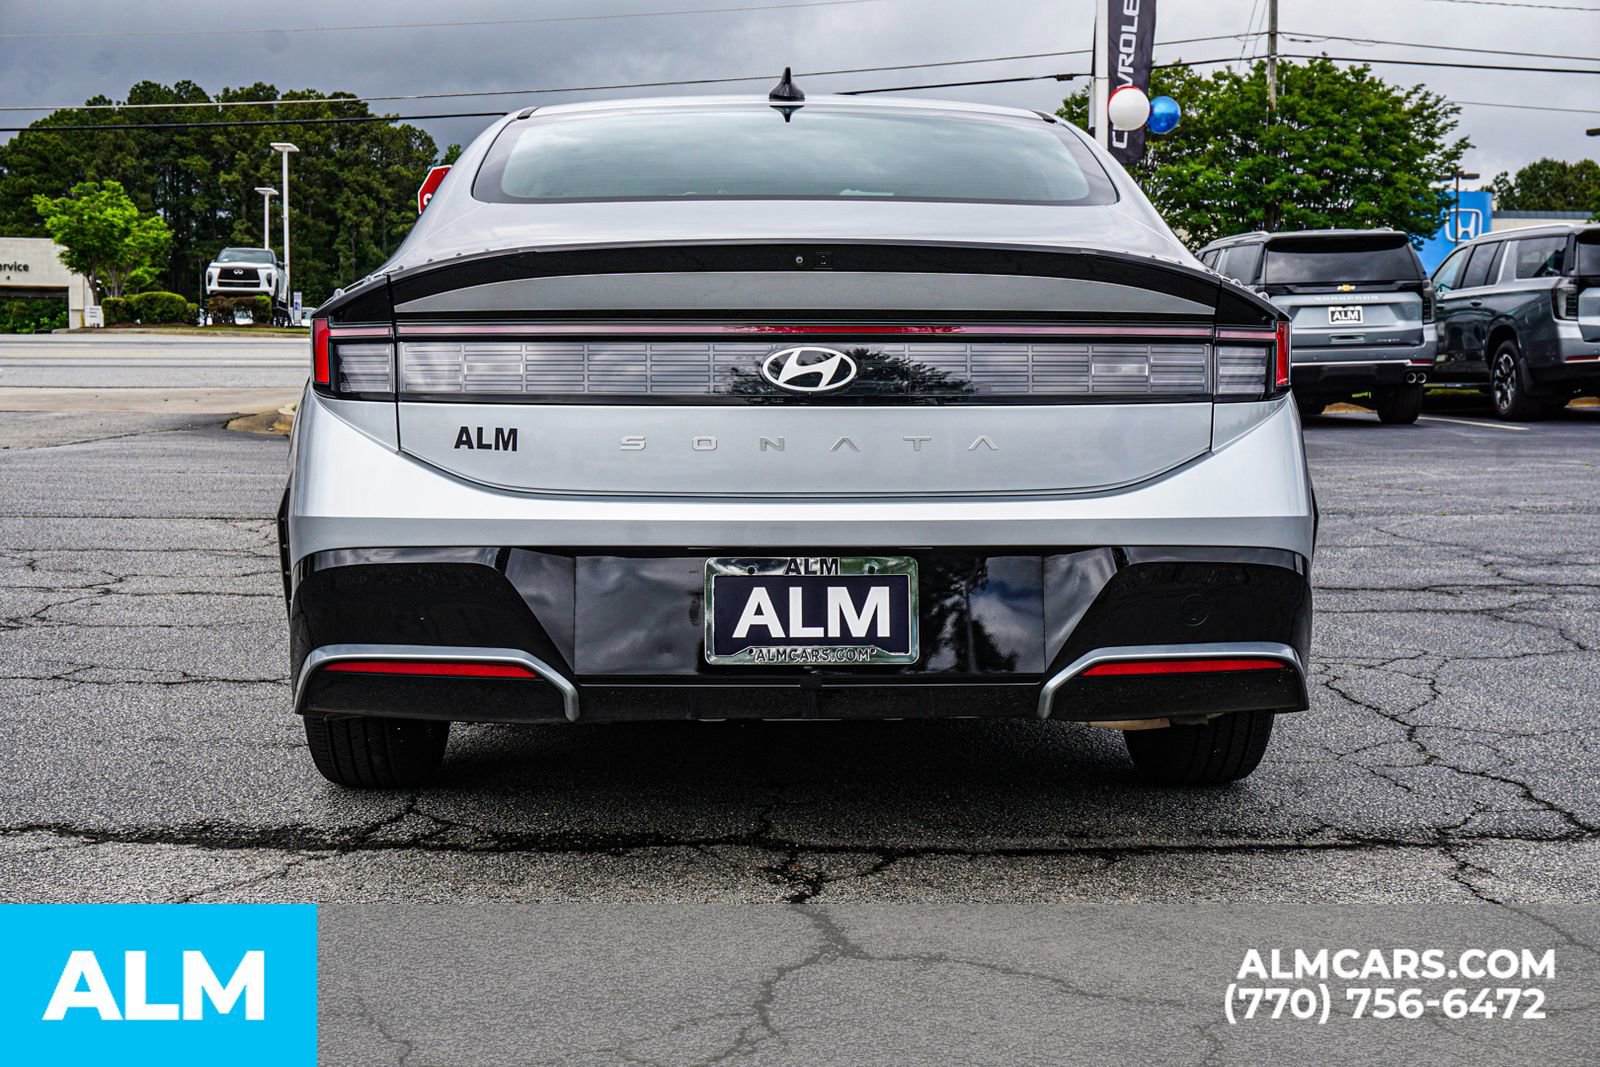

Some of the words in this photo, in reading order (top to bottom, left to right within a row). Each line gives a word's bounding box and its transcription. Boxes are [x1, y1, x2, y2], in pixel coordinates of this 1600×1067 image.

[1112, 0, 1140, 149] CVROLE
[1333, 310, 1359, 320] ALM
[454, 426, 518, 451] ALM
[620, 434, 999, 451] SONATA
[784, 558, 839, 575] ALM
[732, 586, 890, 638] ALM
[755, 646, 870, 662] ALMCARS.COM
